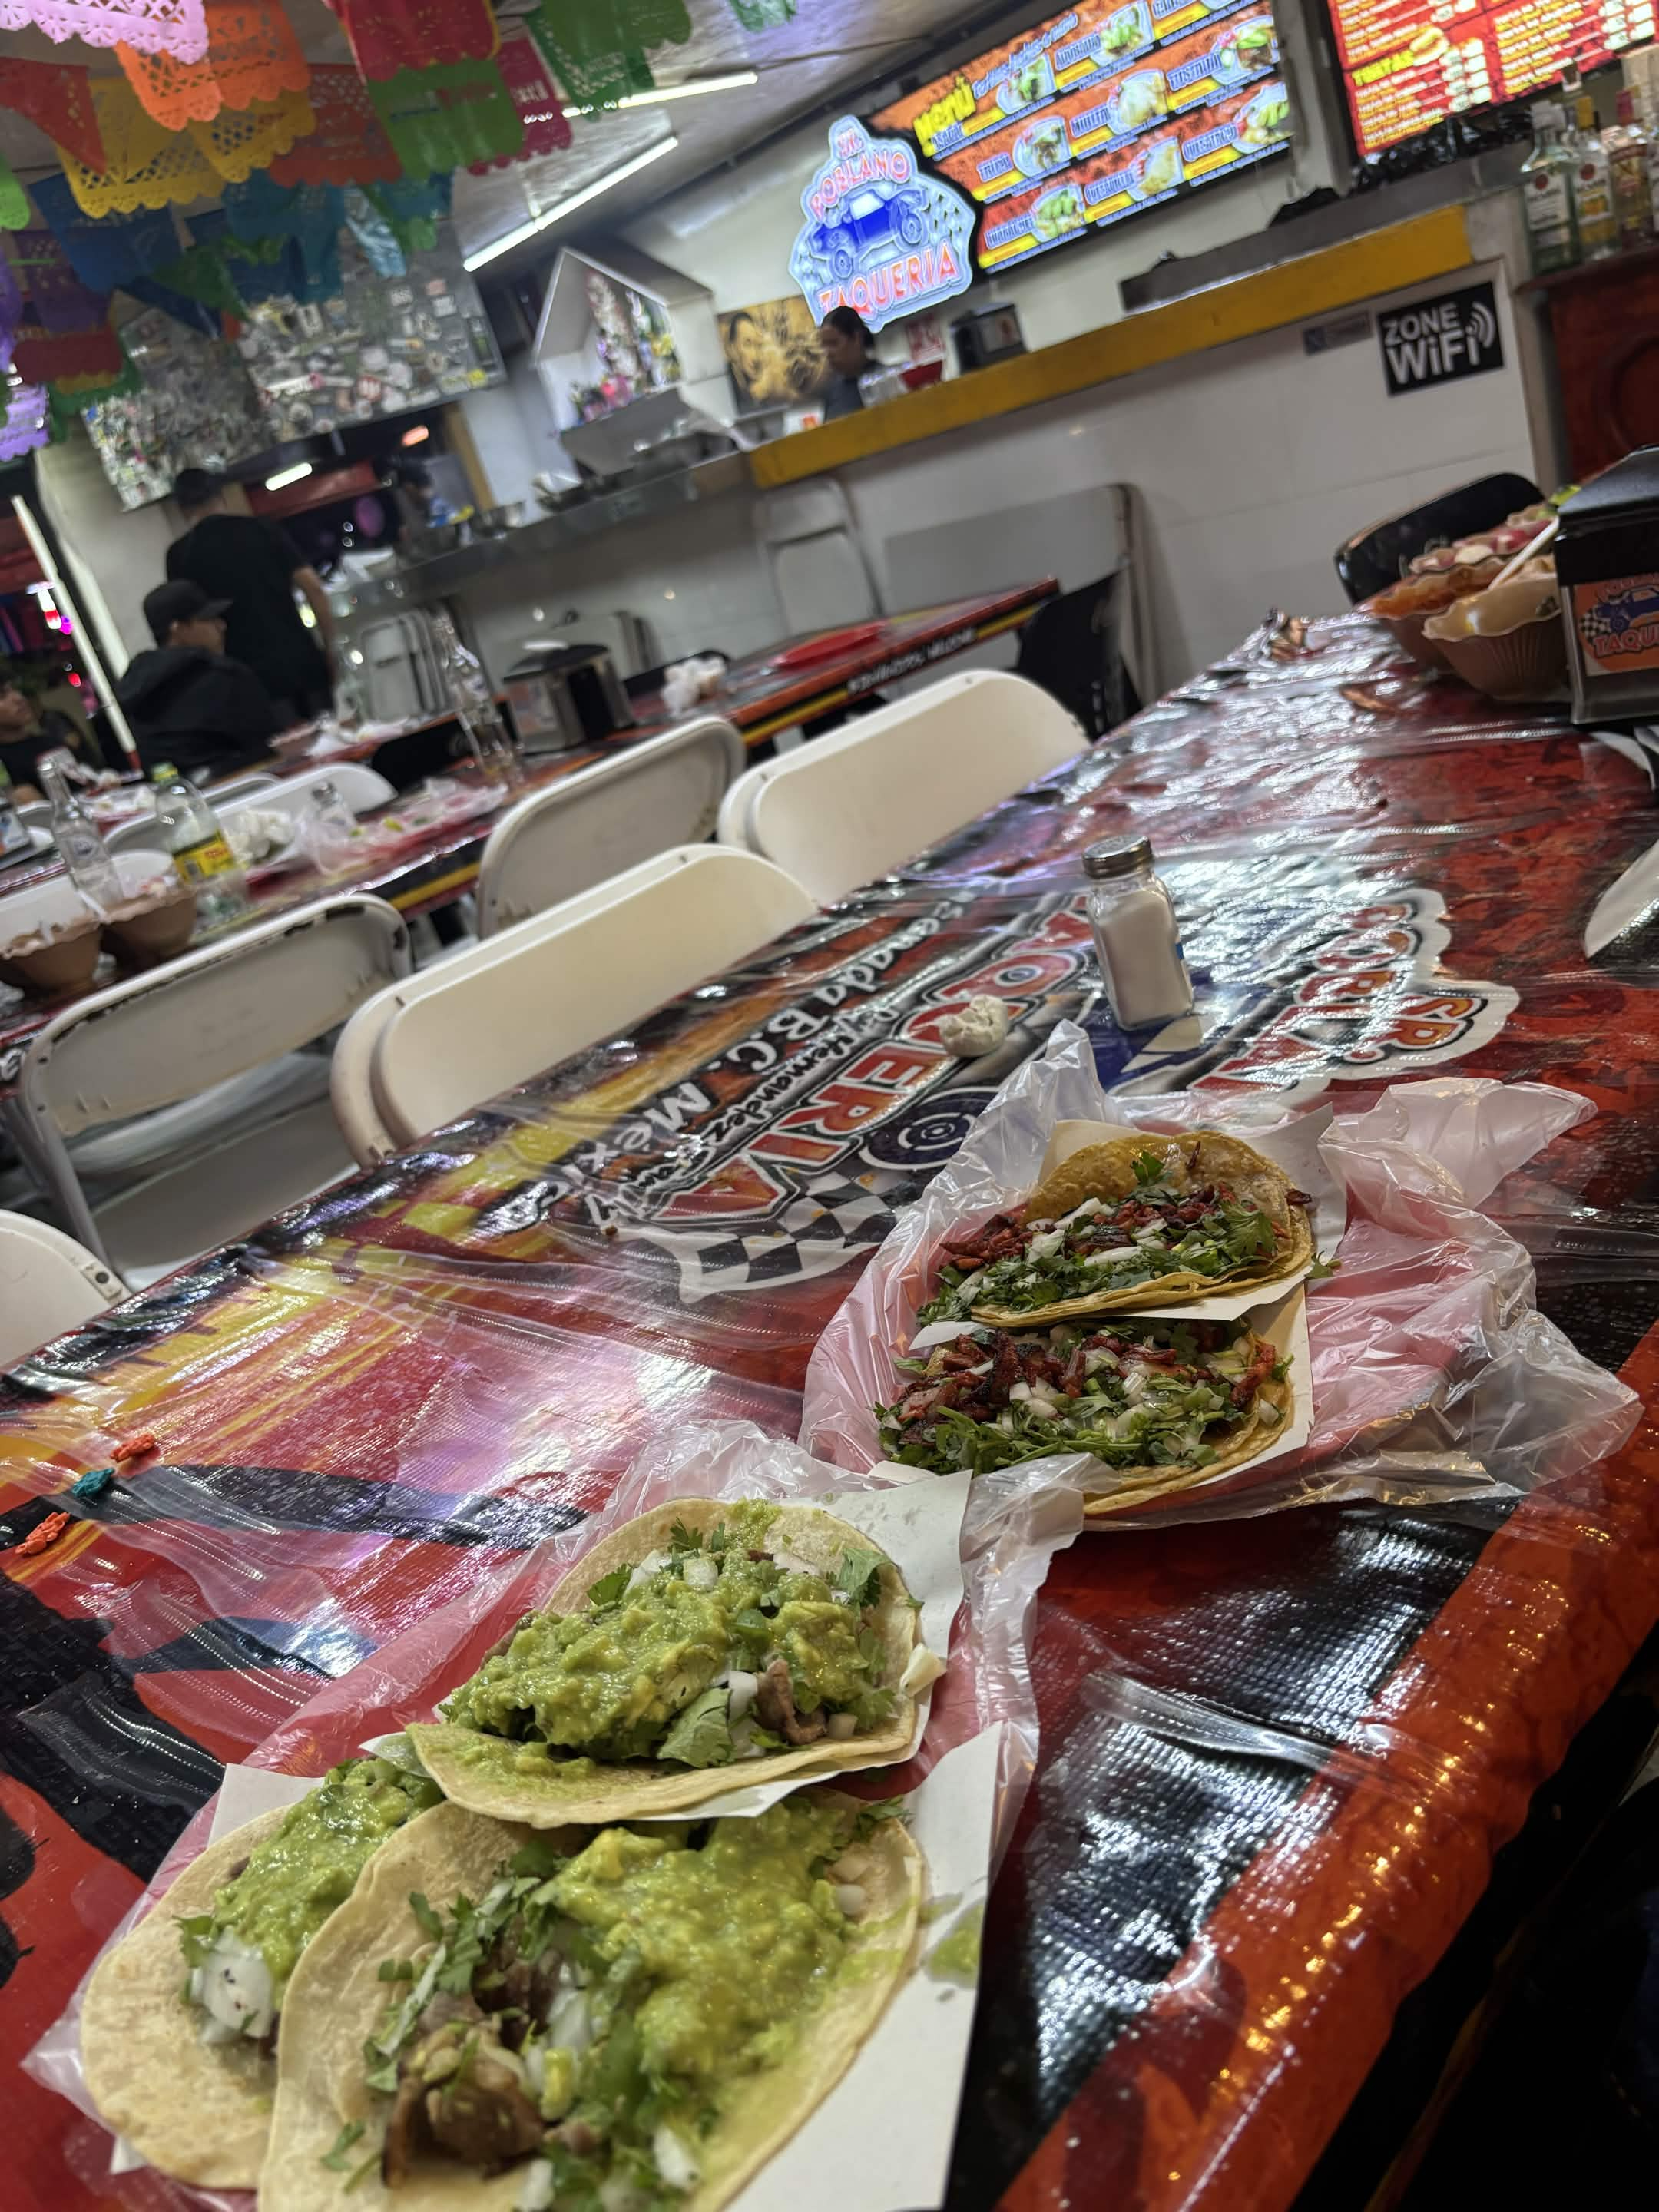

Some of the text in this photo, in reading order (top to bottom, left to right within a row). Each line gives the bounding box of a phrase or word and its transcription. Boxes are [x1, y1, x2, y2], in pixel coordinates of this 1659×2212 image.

[810, 150, 910, 224] POBLANO
[818, 240, 959, 316] TAQUERIA
[1384, 303, 1459, 345] ZONE
[1386, 326, 1481, 384] WiFi
[813, 891, 975, 1006] senada
[1188, 904, 1411, 1091] POBLA
[656, 894, 1095, 1219] AQUERIA
